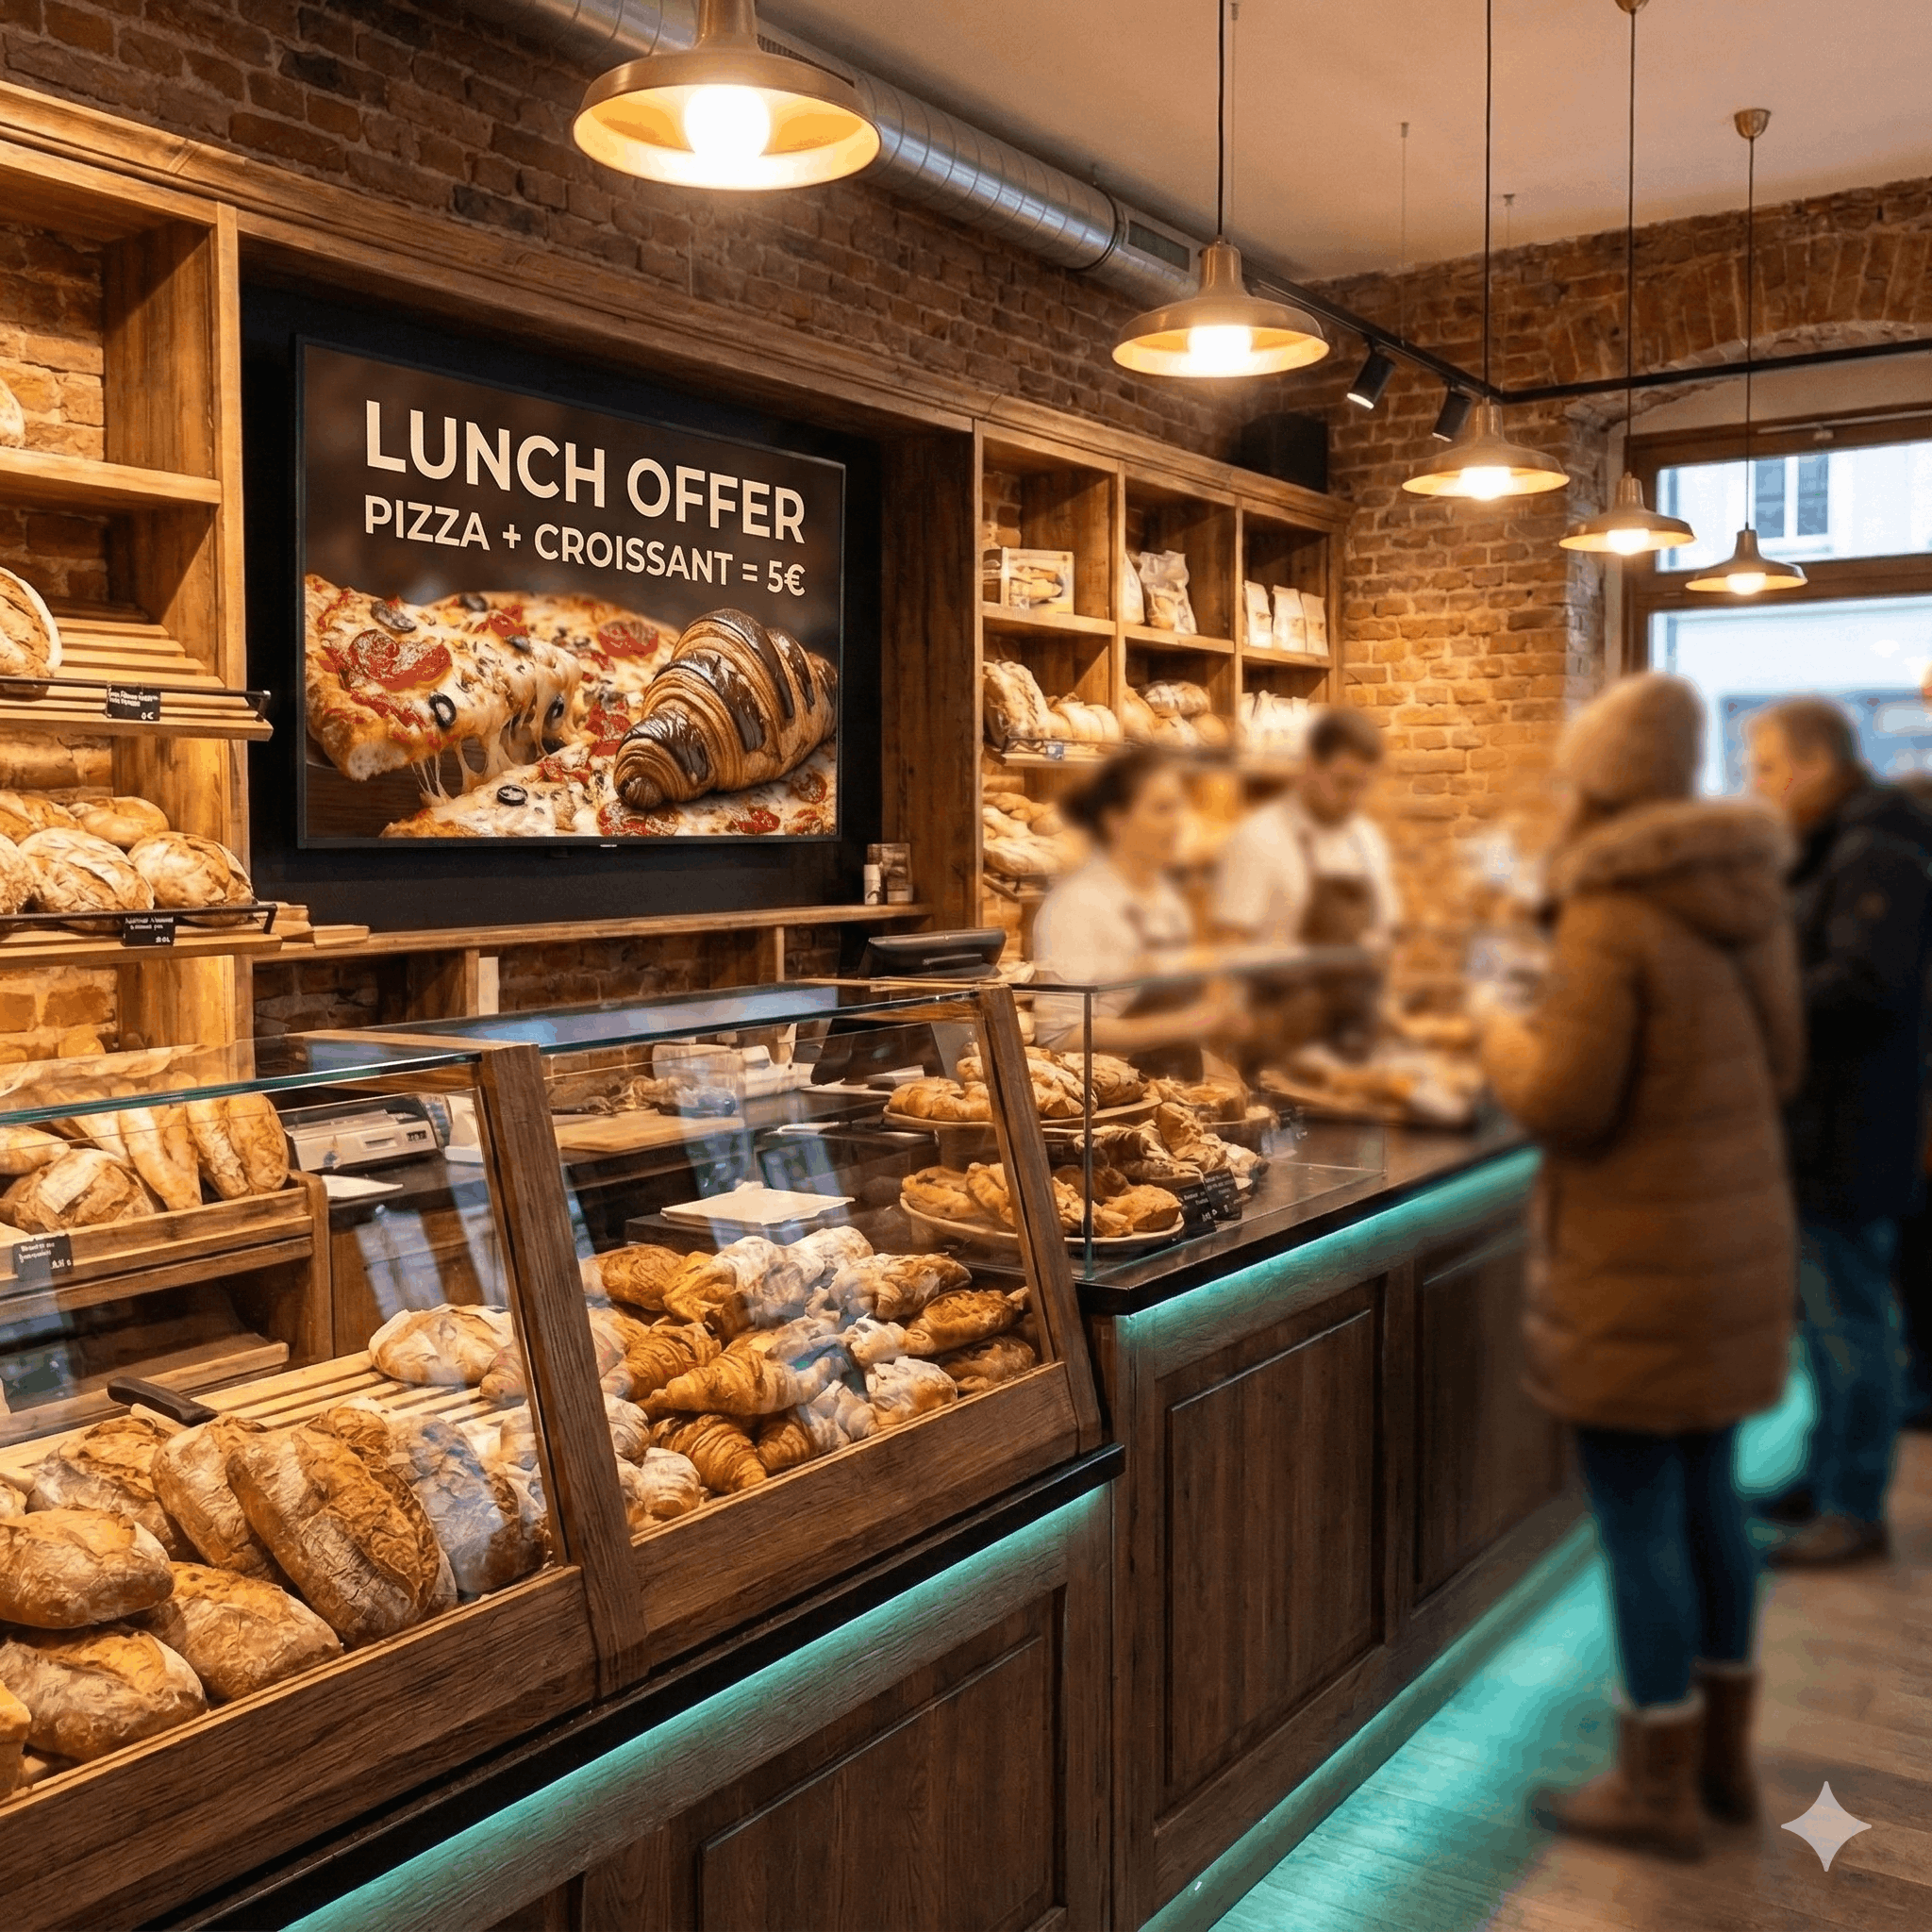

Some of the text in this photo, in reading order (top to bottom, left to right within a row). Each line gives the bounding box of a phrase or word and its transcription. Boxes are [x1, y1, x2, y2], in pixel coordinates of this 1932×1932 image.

[365, 399, 807, 545] LUNCH OFFER
[364, 494, 807, 597] PIZZA + CROISSANT = 5€
